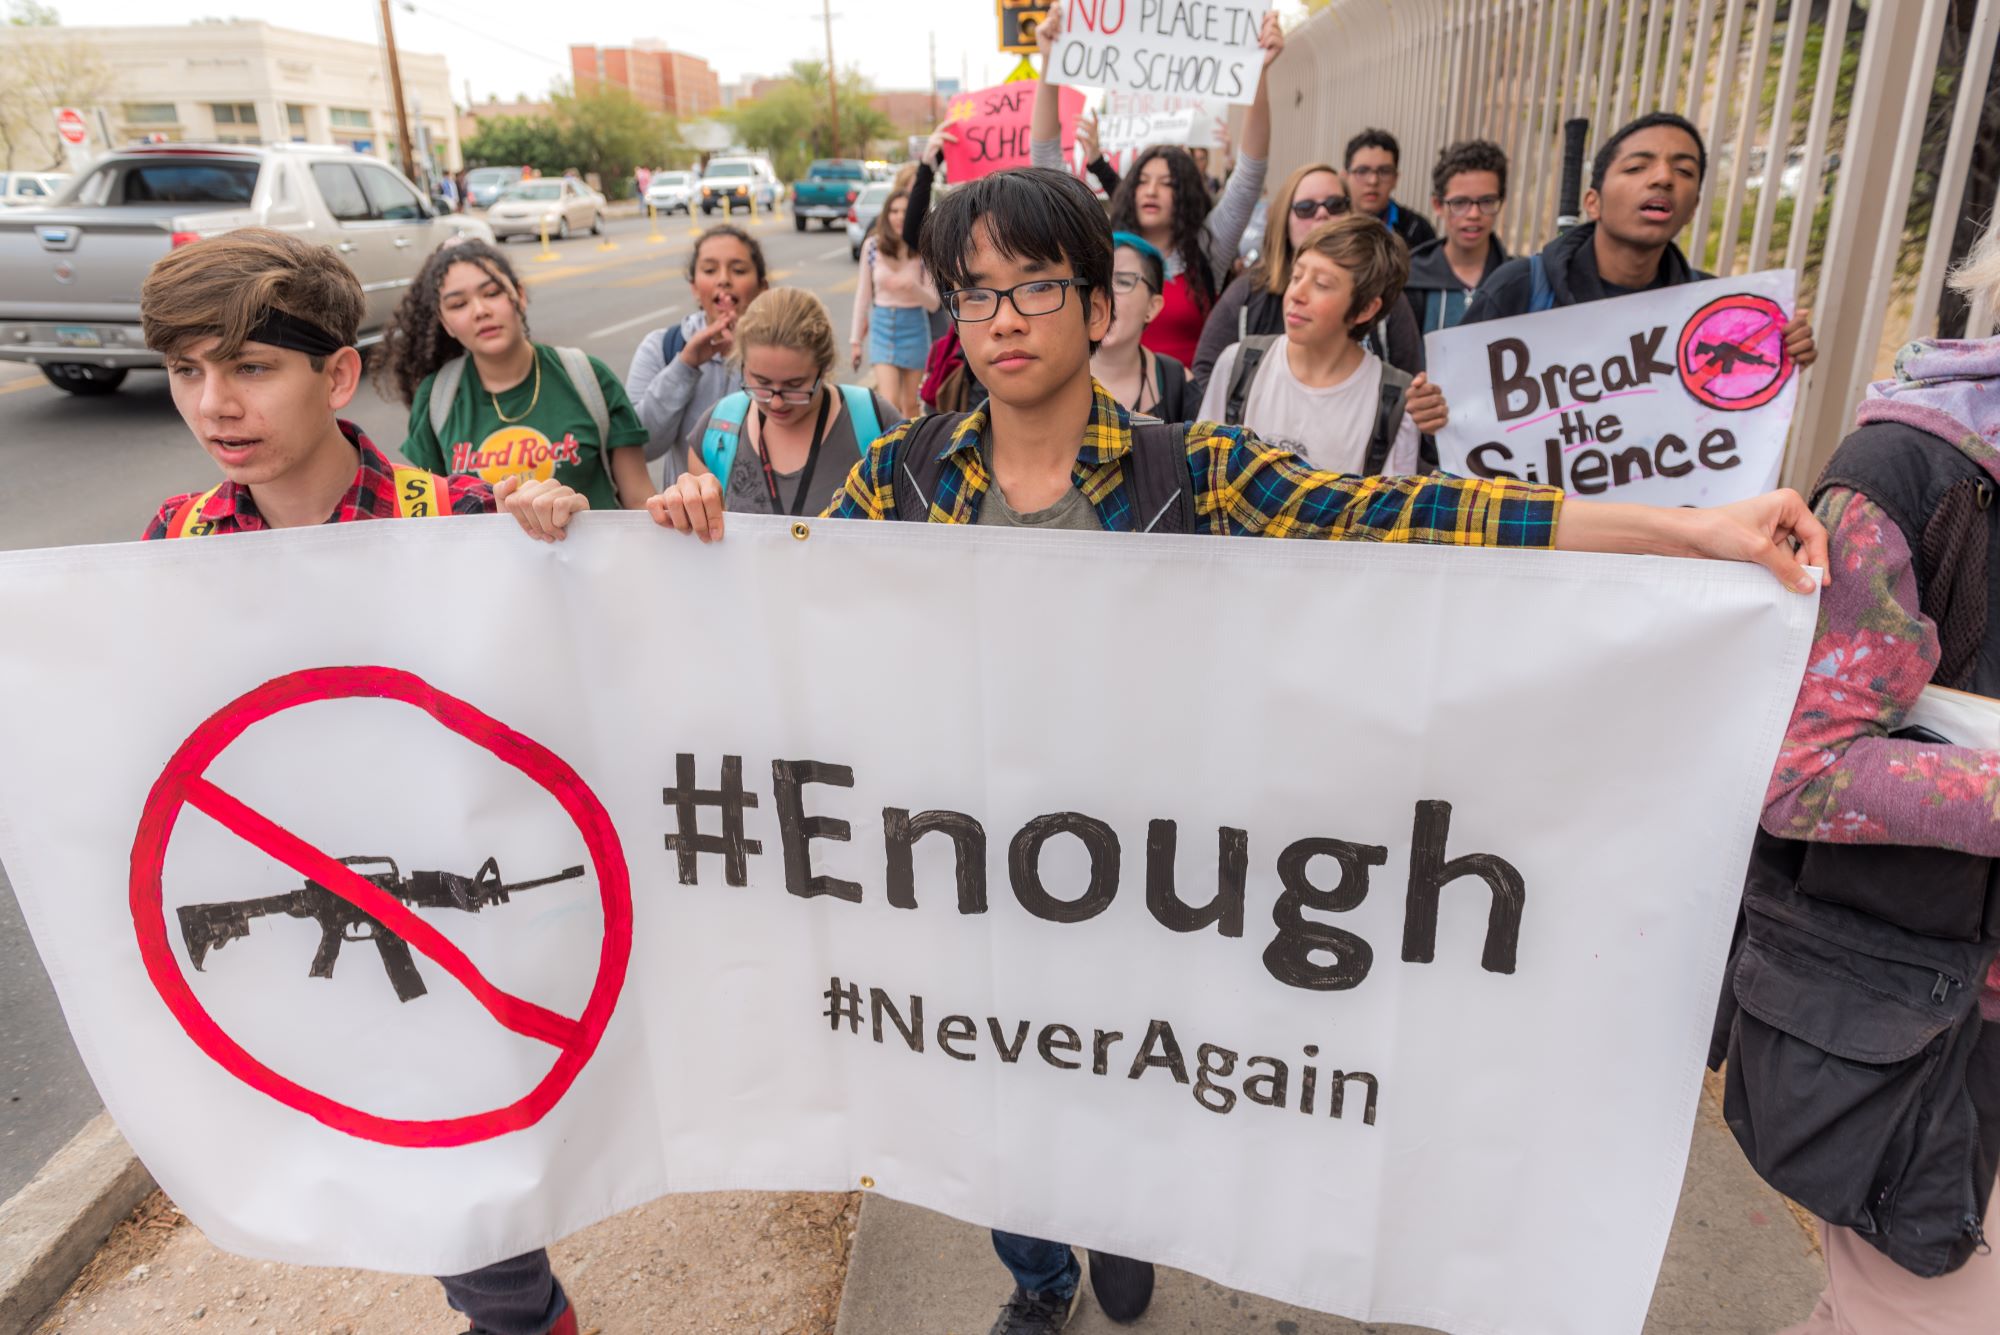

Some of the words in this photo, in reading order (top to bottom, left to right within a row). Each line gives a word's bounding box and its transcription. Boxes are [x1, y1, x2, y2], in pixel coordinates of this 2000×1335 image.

[1140, 0, 1218, 42] PLACE
[1223, 8, 1266, 46] IN
[1062, 40, 1121, 83] OUR
[1129, 49, 1245, 97] SCHOOLS
[984, 90, 1033, 116] SAF
[1487, 326, 1676, 422] Break
[452, 440, 513, 474] Hard
[517, 432, 582, 469] Rock
[1559, 411, 1623, 446] the
[663, 753, 1525, 990] #Enough
[823, 976, 1379, 1126] #NeverAgain
